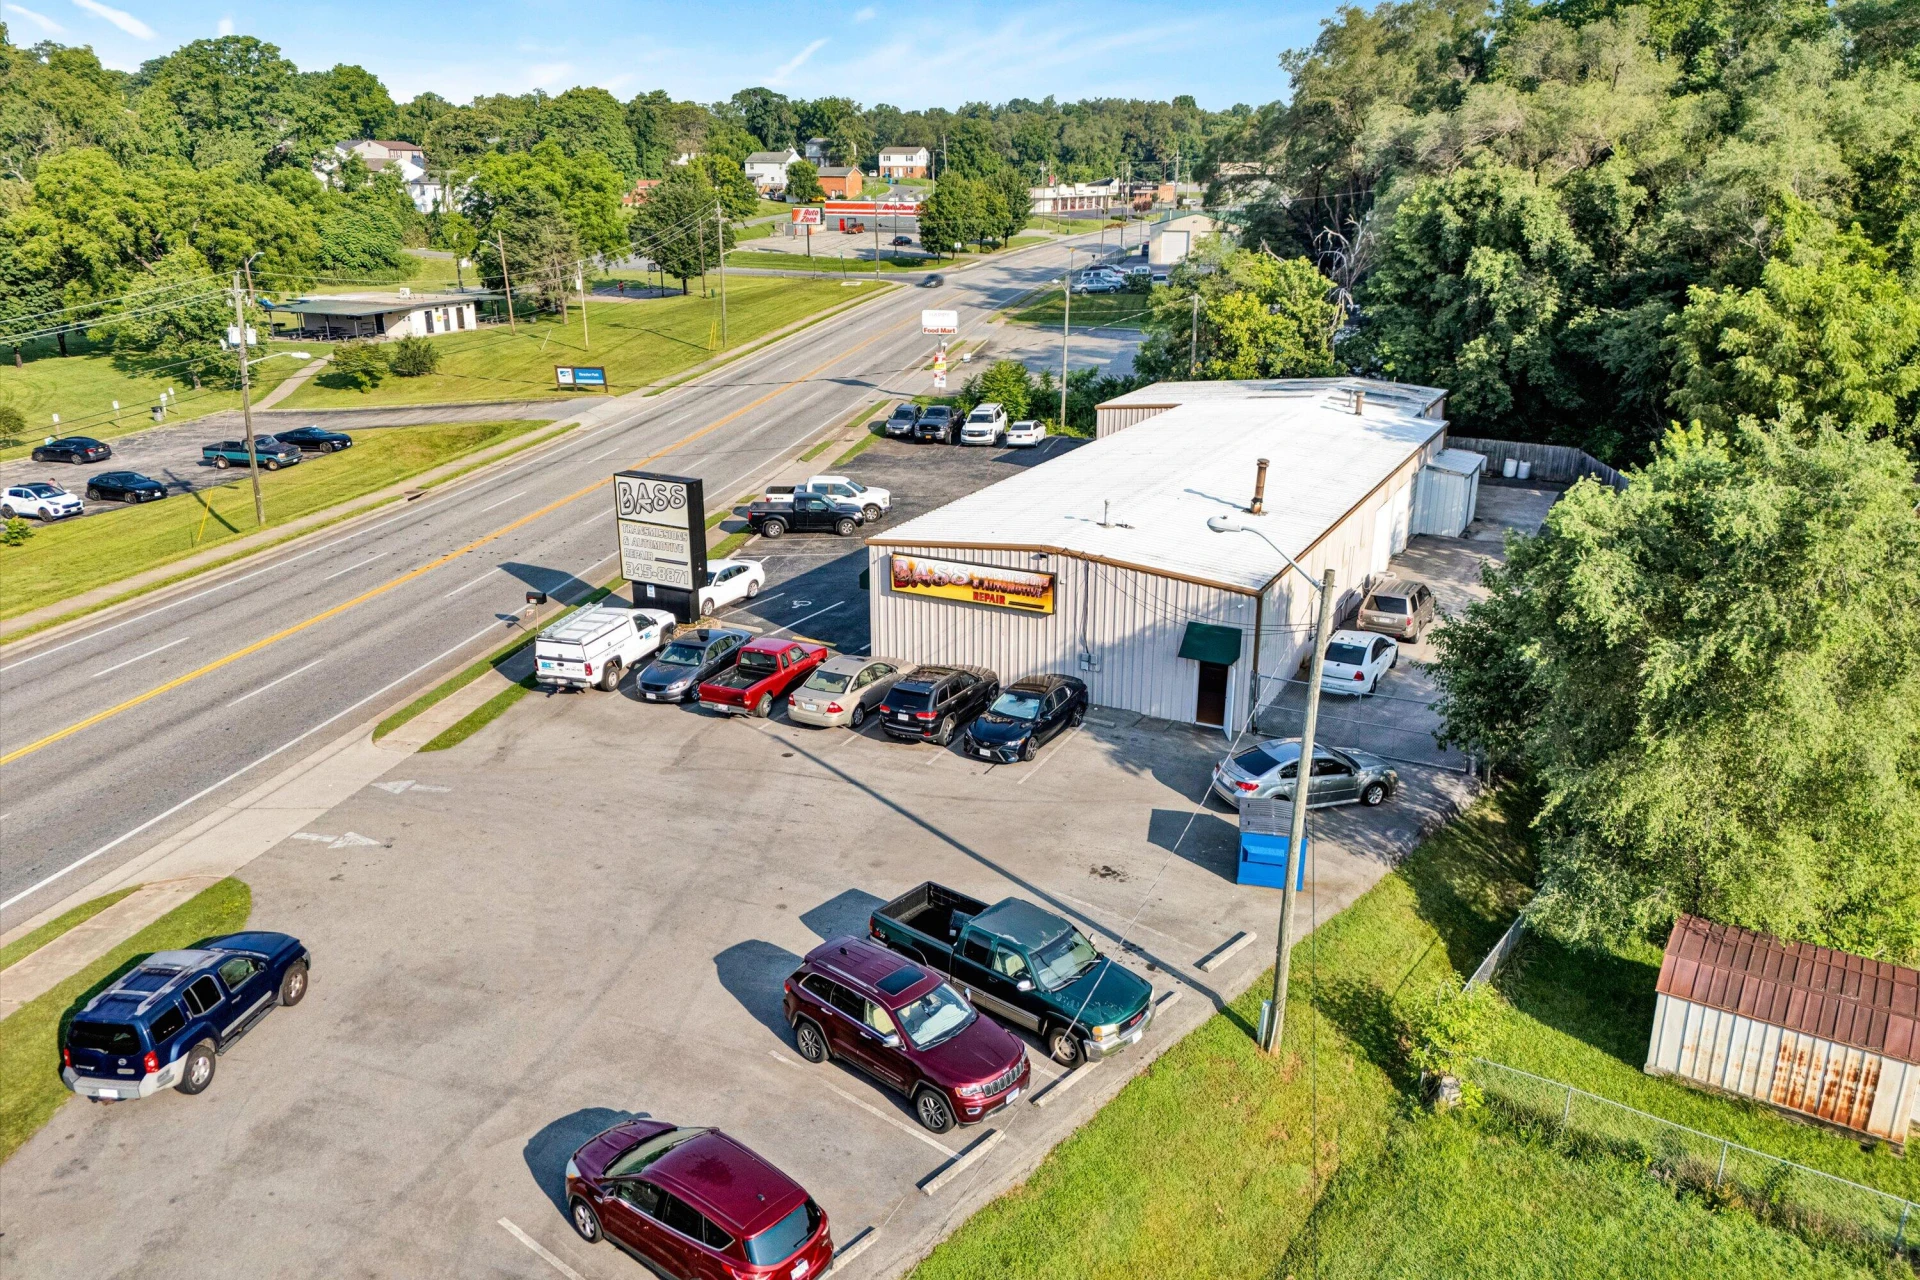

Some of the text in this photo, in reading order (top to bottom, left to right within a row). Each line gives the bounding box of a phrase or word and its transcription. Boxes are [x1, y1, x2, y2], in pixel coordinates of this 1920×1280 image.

[803, 208, 819, 216] Auto
[618, 481, 687, 515] BASS
[622, 524, 688, 542] TRANSMISSIONS
[623, 535, 684, 554] & AUTOMOTIVE
[624, 548, 654, 562] REPAIR
[625, 561, 689, 585] 345-8871
[893, 559, 970, 587] BASS
[972, 591, 1006, 605] REPAIR
